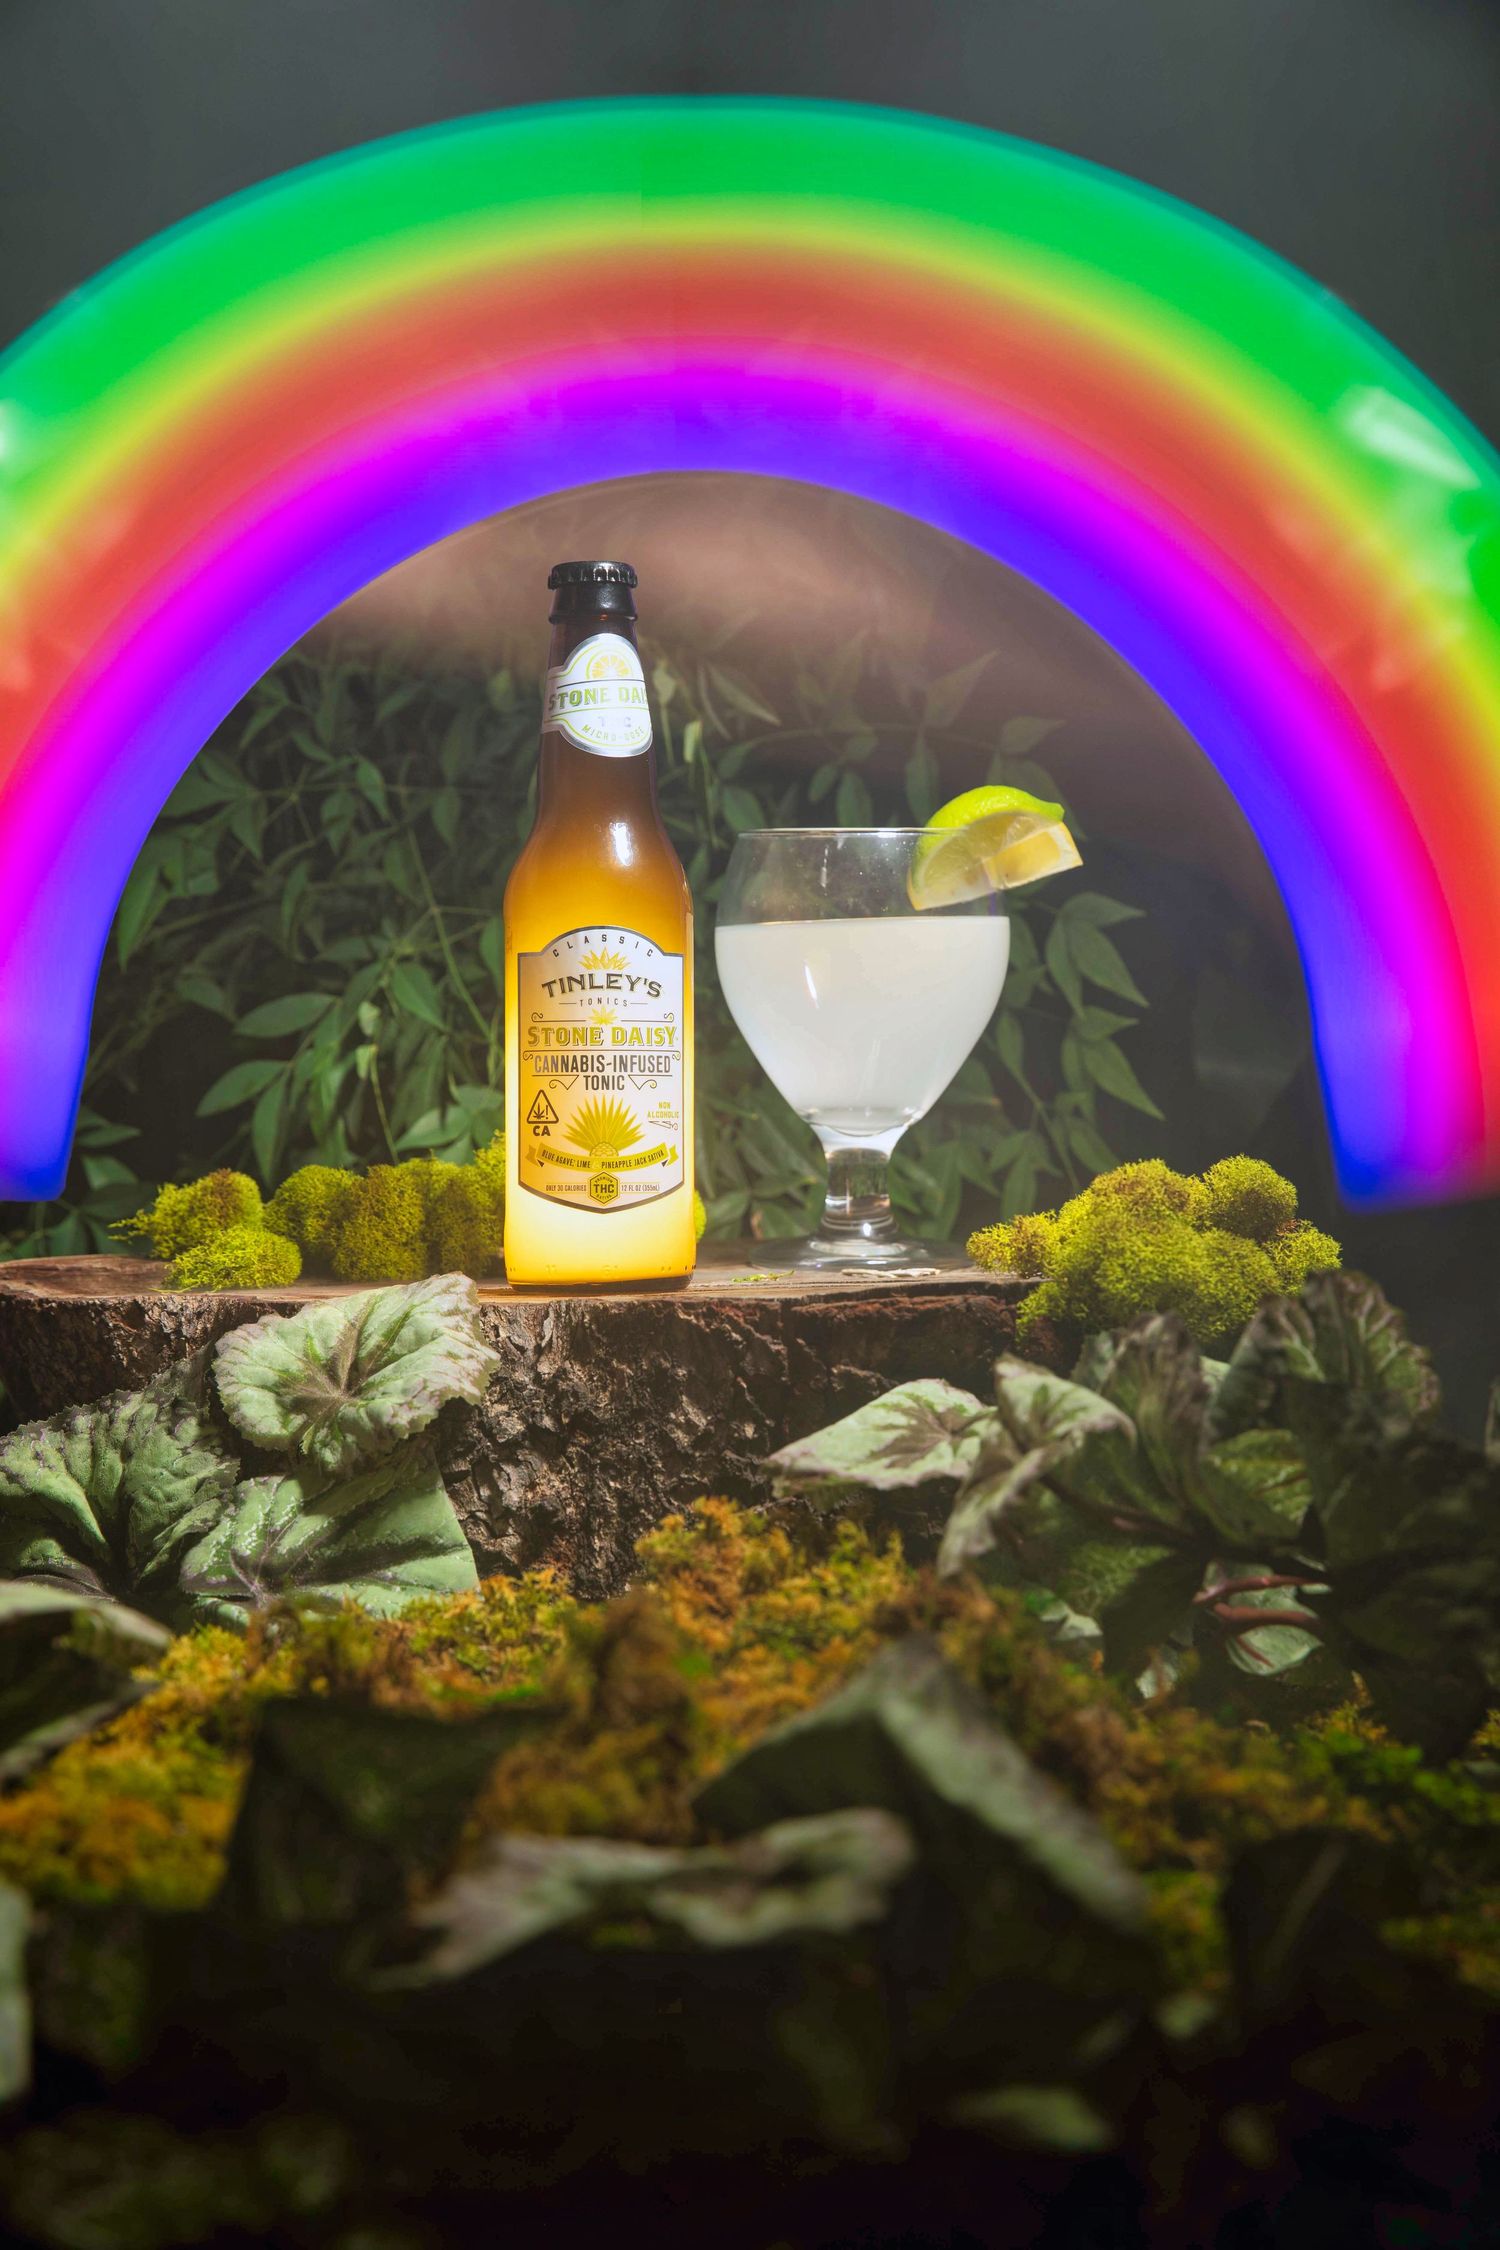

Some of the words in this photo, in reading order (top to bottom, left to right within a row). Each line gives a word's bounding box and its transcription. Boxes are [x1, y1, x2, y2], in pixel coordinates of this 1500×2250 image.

[548, 688, 610, 711] STONE
[552, 934, 654, 958] CLASSIC
[541, 973, 663, 998] TINLEY'S
[579, 997, 628, 1007] TONICS
[527, 1026, 604, 1047] STONE
[611, 1026, 677, 1047] DAISY
[534, 1054, 671, 1073] CANNABIS-INFUSED
[583, 1075, 625, 1091] TONIC
[658, 1101, 671, 1109] NON
[647, 1111, 679, 1119] ALCOHOLIC
[533, 1125, 551, 1137] CA
[541, 1149, 555, 1161] BLUE
[576, 1160, 591, 1169] LIME
[601, 1159, 632, 1169] PINEAPPLE
[634, 1156, 648, 1166] JACK
[647, 1149, 665, 1162] SATIVA
[545, 1184, 556, 1192] ONLY
[557, 1184, 564, 1192] 30
[564, 1184, 587, 1192] CALORIES
[593, 1184, 615, 1193] THC
[621, 1184, 627, 1192] 12
[628, 1184, 634, 1192] FL
[635, 1184, 642, 1192] OZ
